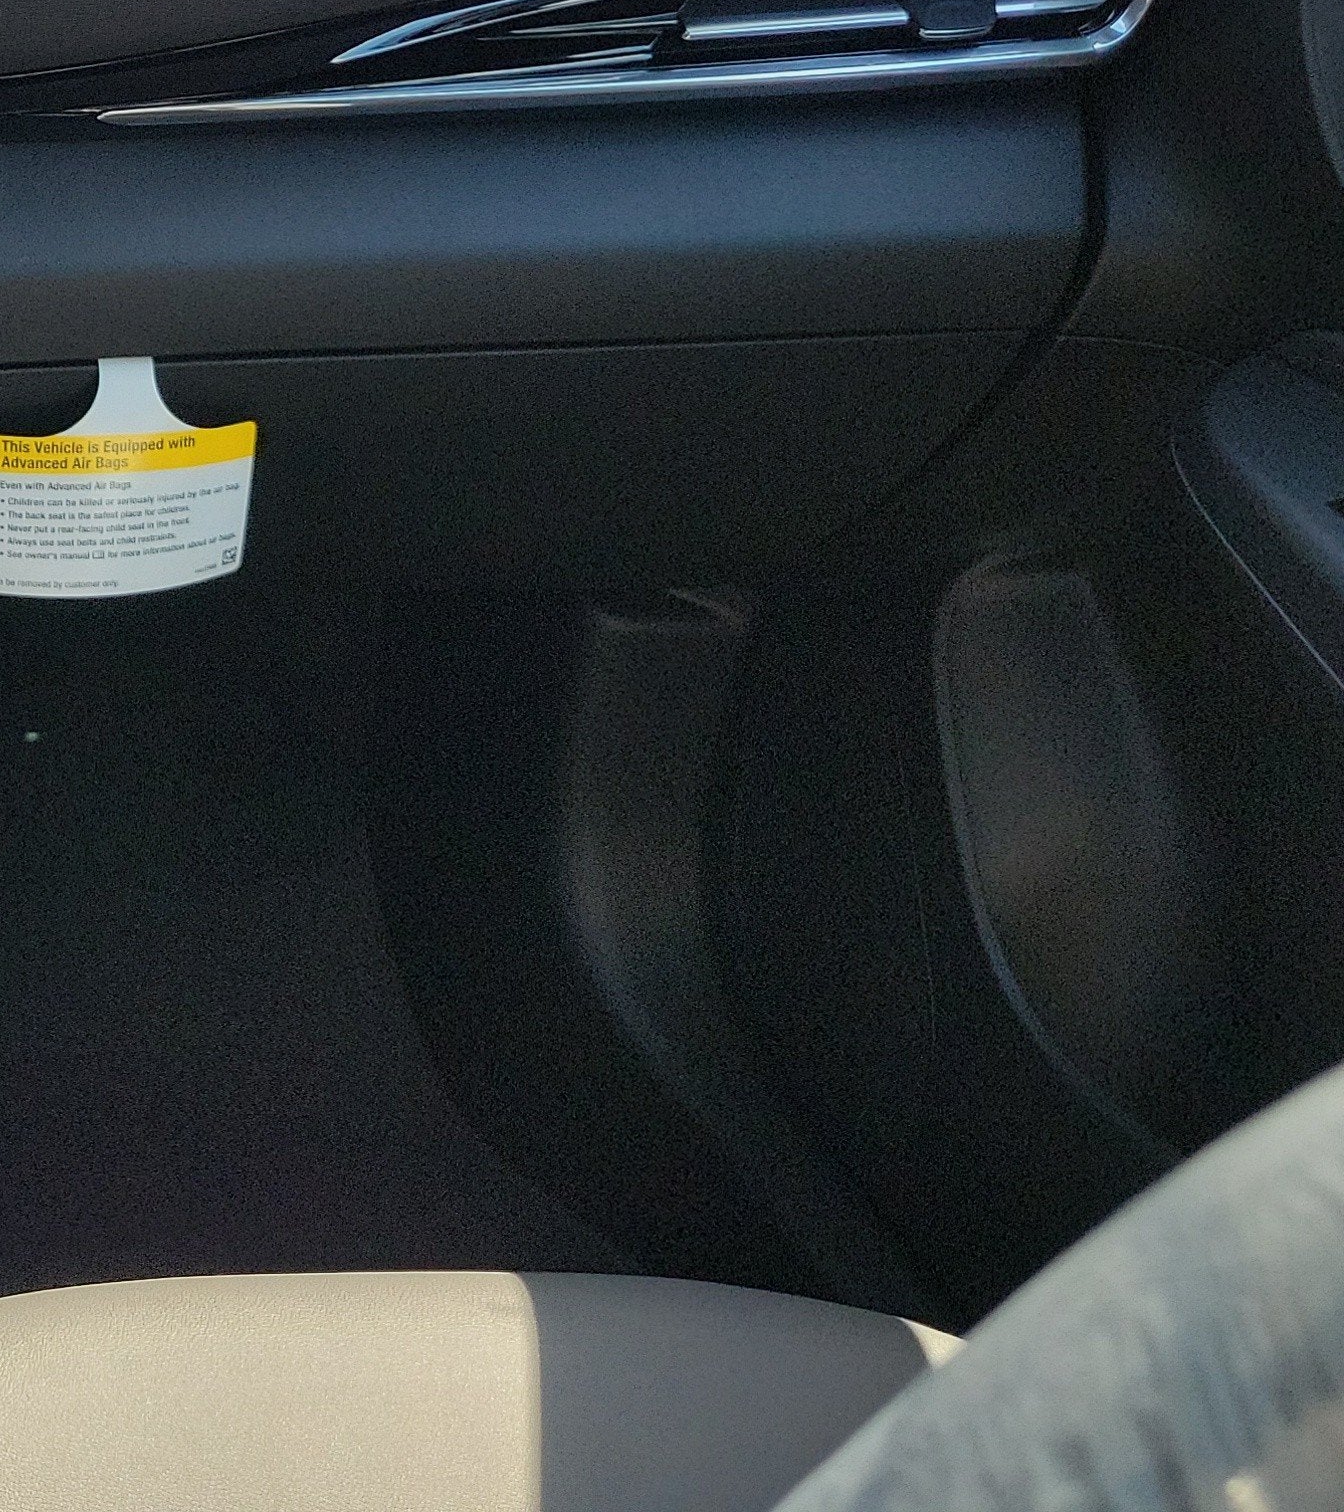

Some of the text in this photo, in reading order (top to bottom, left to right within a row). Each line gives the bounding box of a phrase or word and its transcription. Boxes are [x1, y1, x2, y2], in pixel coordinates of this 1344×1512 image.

[2, 436, 196, 456] This Vehicle is Equipped with
[1, 456, 129, 471] Advanced Air Bags
[0, 480, 22, 490] Even
[25, 481, 44, 490] with
[48, 482, 91, 491] Advanced
[94, 481, 106, 490] Air
[7, 497, 44, 507] Children
[65, 498, 76, 506] be
[79, 498, 103, 506] killed
[116, 495, 154, 505] seriously
[157, 492, 185, 503] injured
[187, 490, 196, 499] by
[8, 510, 23, 519] The
[25, 511, 45, 519] back
[48, 512, 66, 520] seat
[68, 512, 75, 520] is
[78, 511, 91, 519] the
[93, 510, 118, 519] safest
[120, 510, 143, 519] place
[7, 524, 32, 533] Never
[34, 525, 48, 534] put
[57, 525, 104, 534] rear-facing
[106, 522, 126, 532] child
[128, 522, 144, 530] seat
[7, 537, 37, 547] Always
[77, 538, 97, 546] belts
[99, 538, 114, 546] and
[116, 535, 136, 544] child
[6, 550, 22, 558] See
[60, 551, 90, 559] manual
[5, 577, 15, 586] be
[17, 579, 51, 588] removed
[53, 580, 62, 589] by
[64, 580, 100, 588] customer
